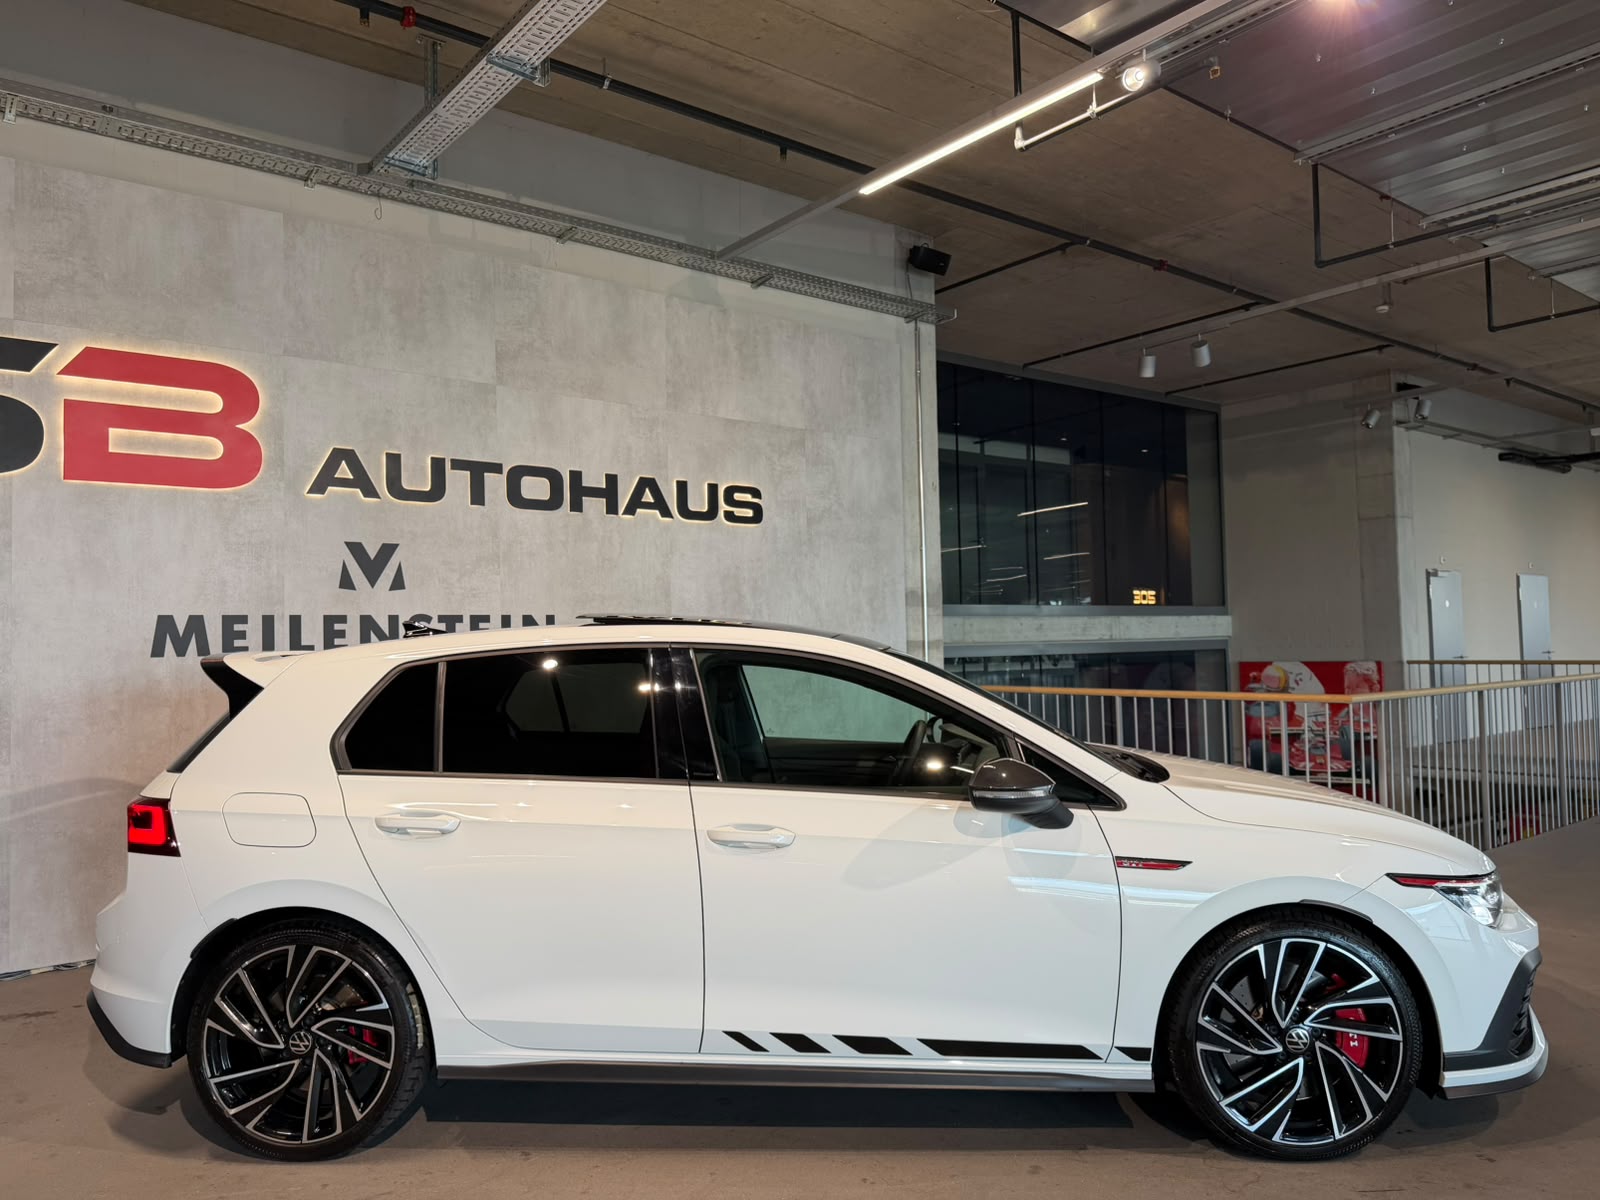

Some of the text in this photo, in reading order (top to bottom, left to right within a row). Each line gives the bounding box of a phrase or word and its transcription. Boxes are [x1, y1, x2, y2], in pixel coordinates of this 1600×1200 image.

[0, 336, 263, 490] B
[305, 446, 764, 525] AUTOHAUS
[150, 613, 556, 658] MEILENT
